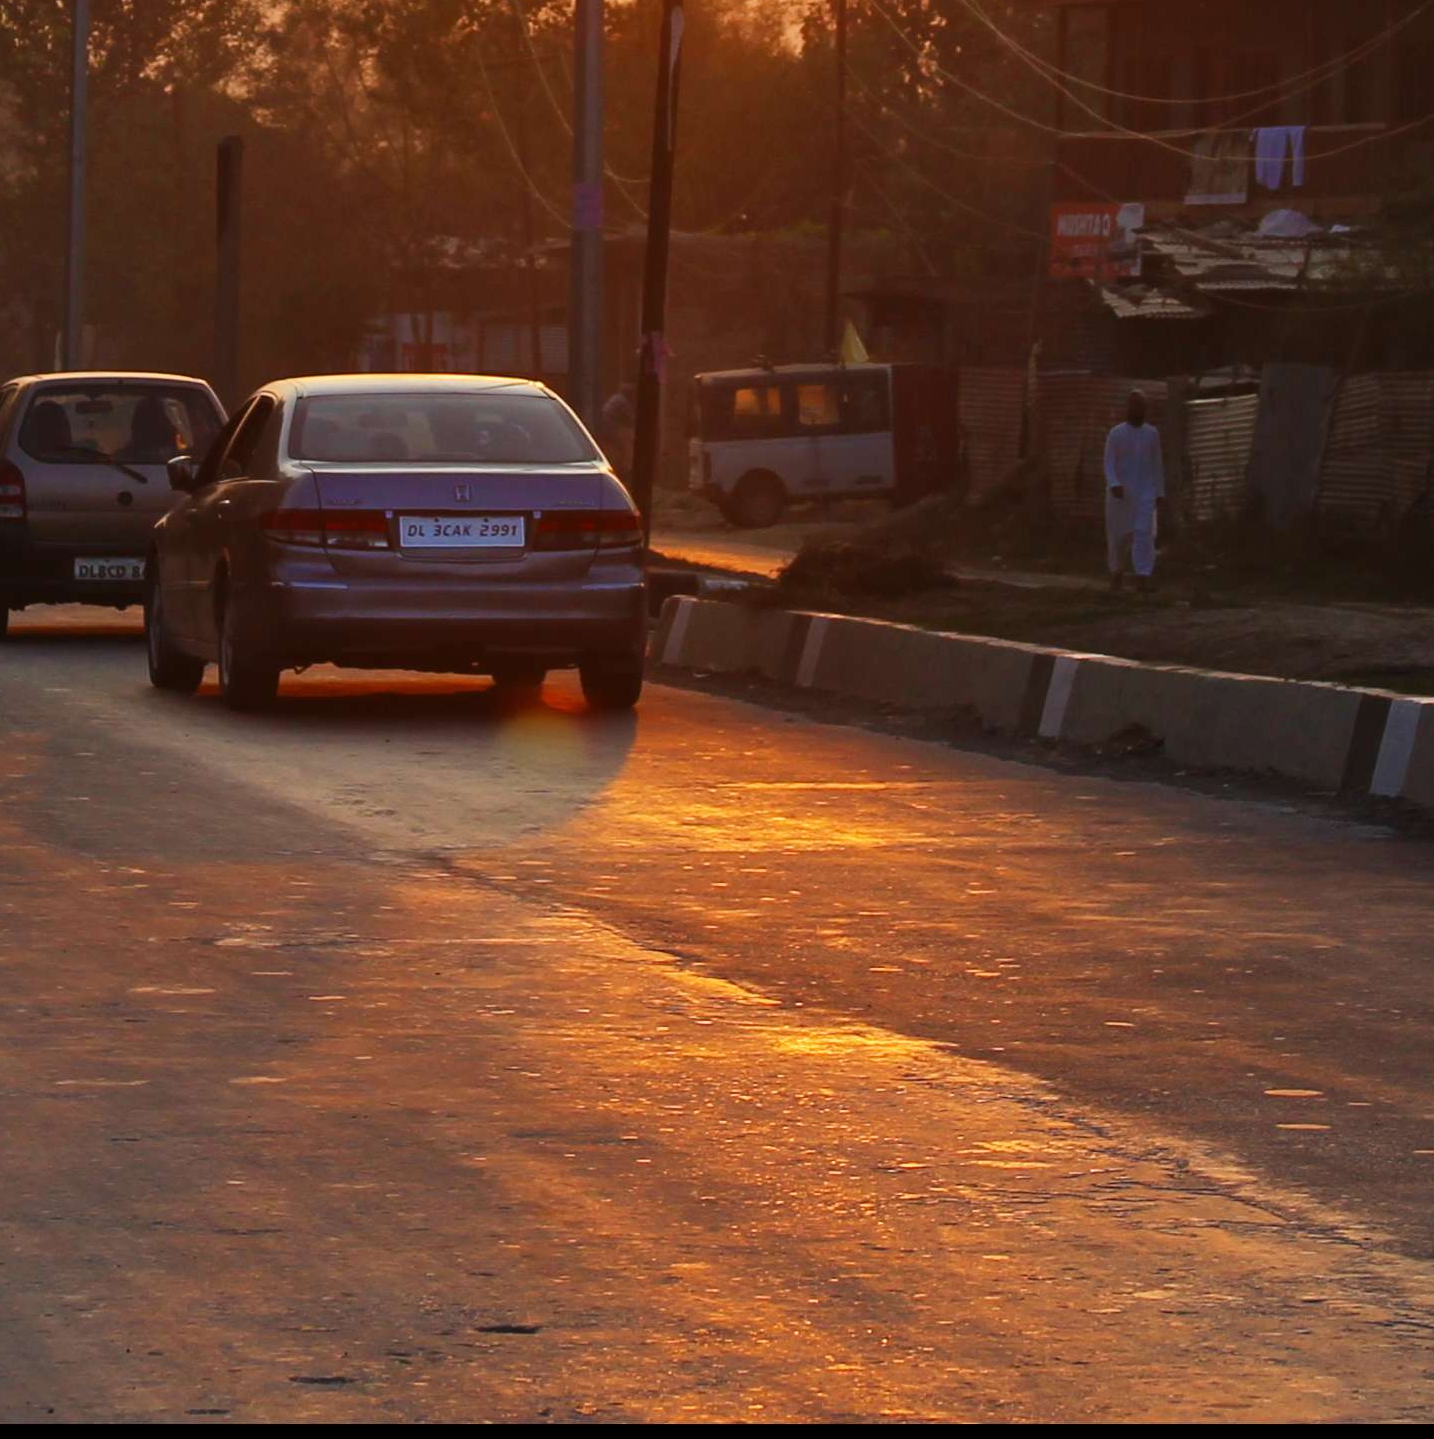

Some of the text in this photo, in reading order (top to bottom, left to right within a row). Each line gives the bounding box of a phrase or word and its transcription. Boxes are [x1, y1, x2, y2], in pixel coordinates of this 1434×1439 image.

[407, 524, 518, 537] DL 3CAK 2991
